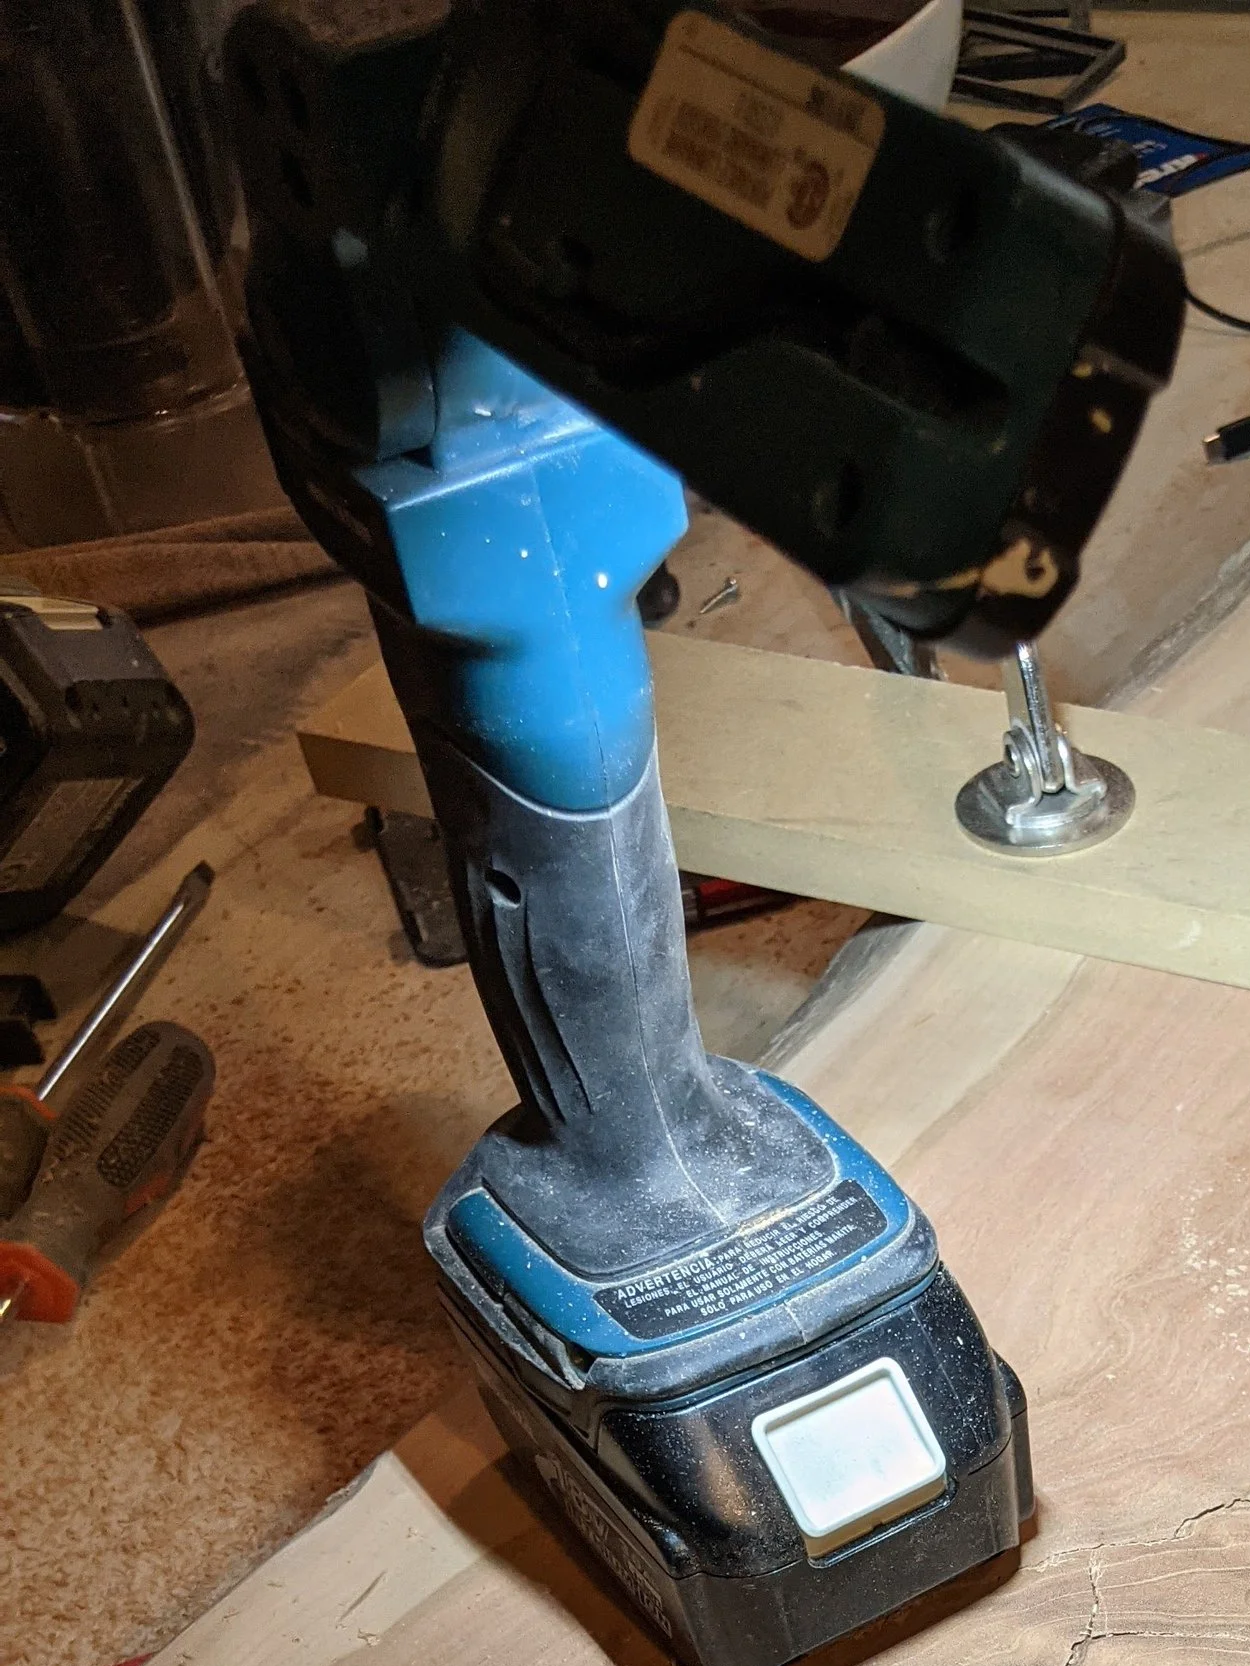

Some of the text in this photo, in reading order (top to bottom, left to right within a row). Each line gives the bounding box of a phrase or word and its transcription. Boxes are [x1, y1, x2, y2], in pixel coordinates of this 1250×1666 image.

[718, 1246, 742, 1263] PARA
[744, 1229, 781, 1249] REDUCIR
[664, 1303, 691, 1317] PARA
[692, 1291, 717, 1308] USAR
[718, 1269, 770, 1298] SOLAMENTE
[769, 1261, 789, 1274] CON
[693, 1263, 733, 1284] USUARIO
[702, 1273, 739, 1292] MANUAL
[741, 1263, 756, 1275] DE
[729, 1288, 755, 1305] PARA
[754, 1281, 773, 1294] USO
[776, 1274, 790, 1284] EN
[791, 1268, 804, 1277] EL
